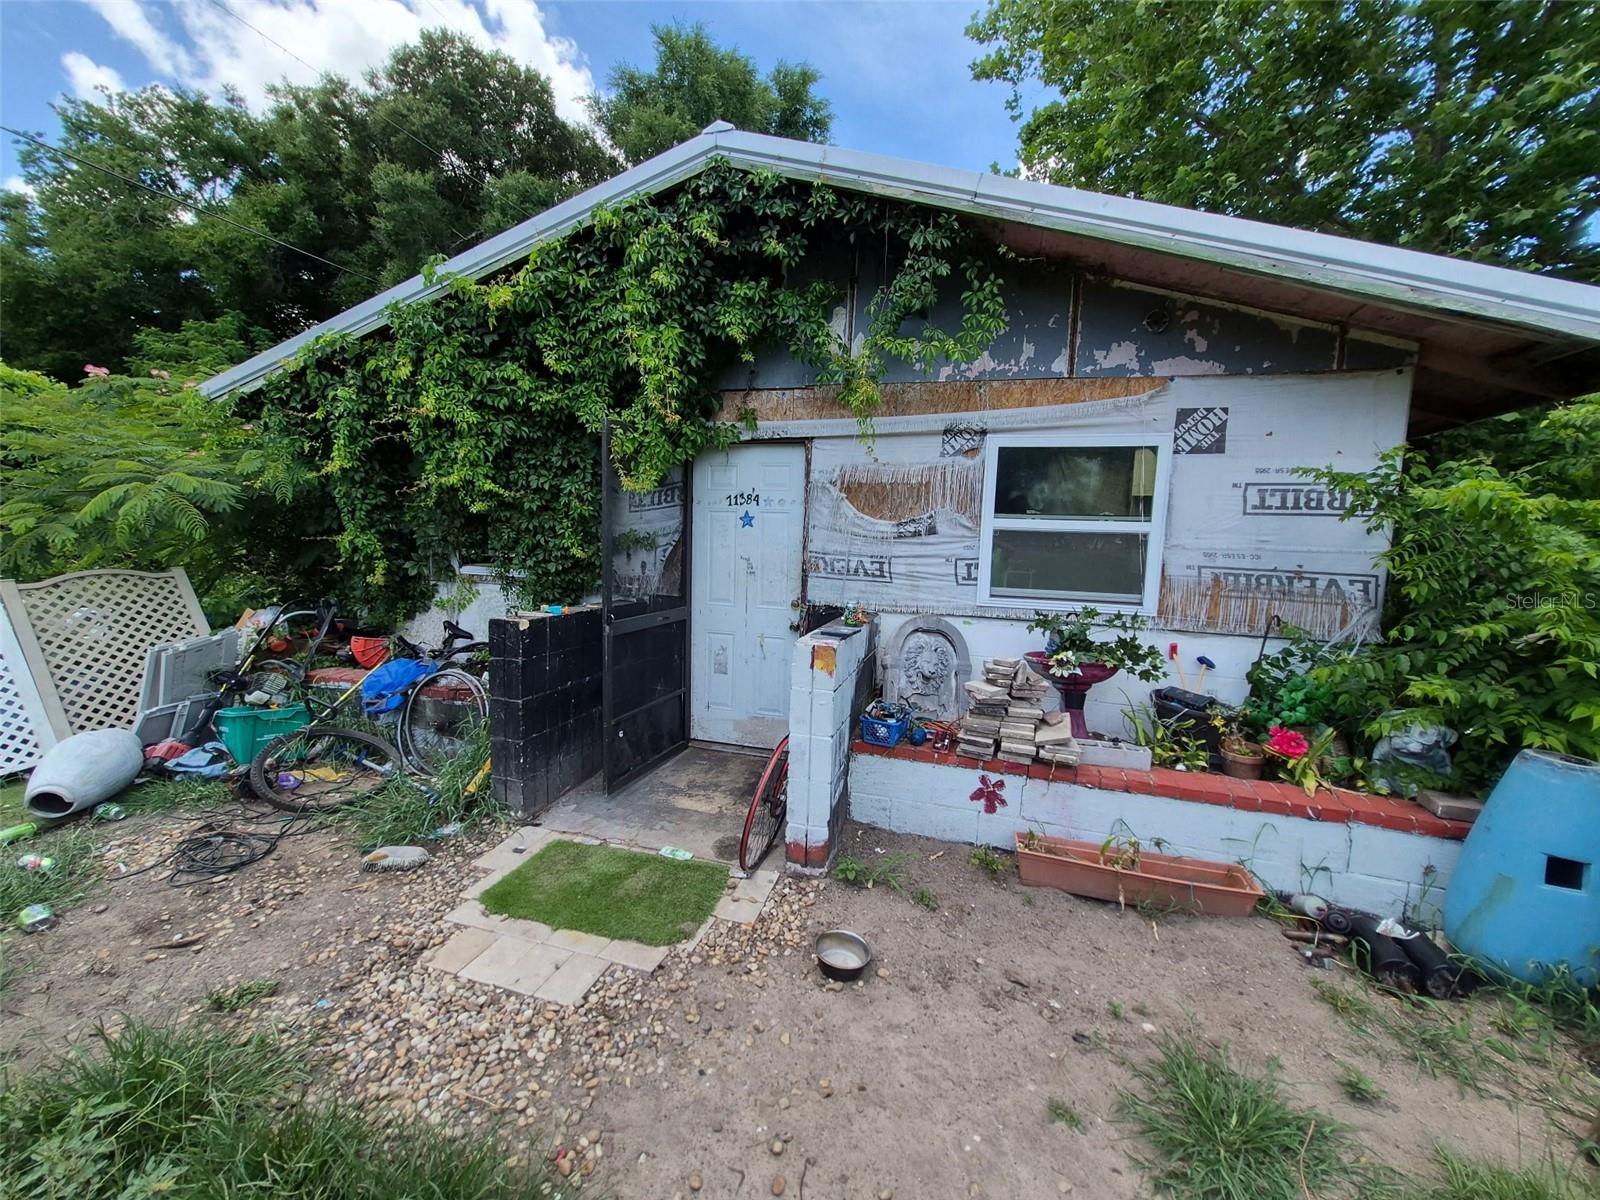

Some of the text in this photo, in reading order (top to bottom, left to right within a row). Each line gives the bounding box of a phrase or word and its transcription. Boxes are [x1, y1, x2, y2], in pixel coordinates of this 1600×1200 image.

[1173, 408, 1208, 438] DEPOT
[1173, 408, 1229, 455] HOME
[1198, 431, 1221, 450] THE
[1251, 487, 1358, 511] RBILT
